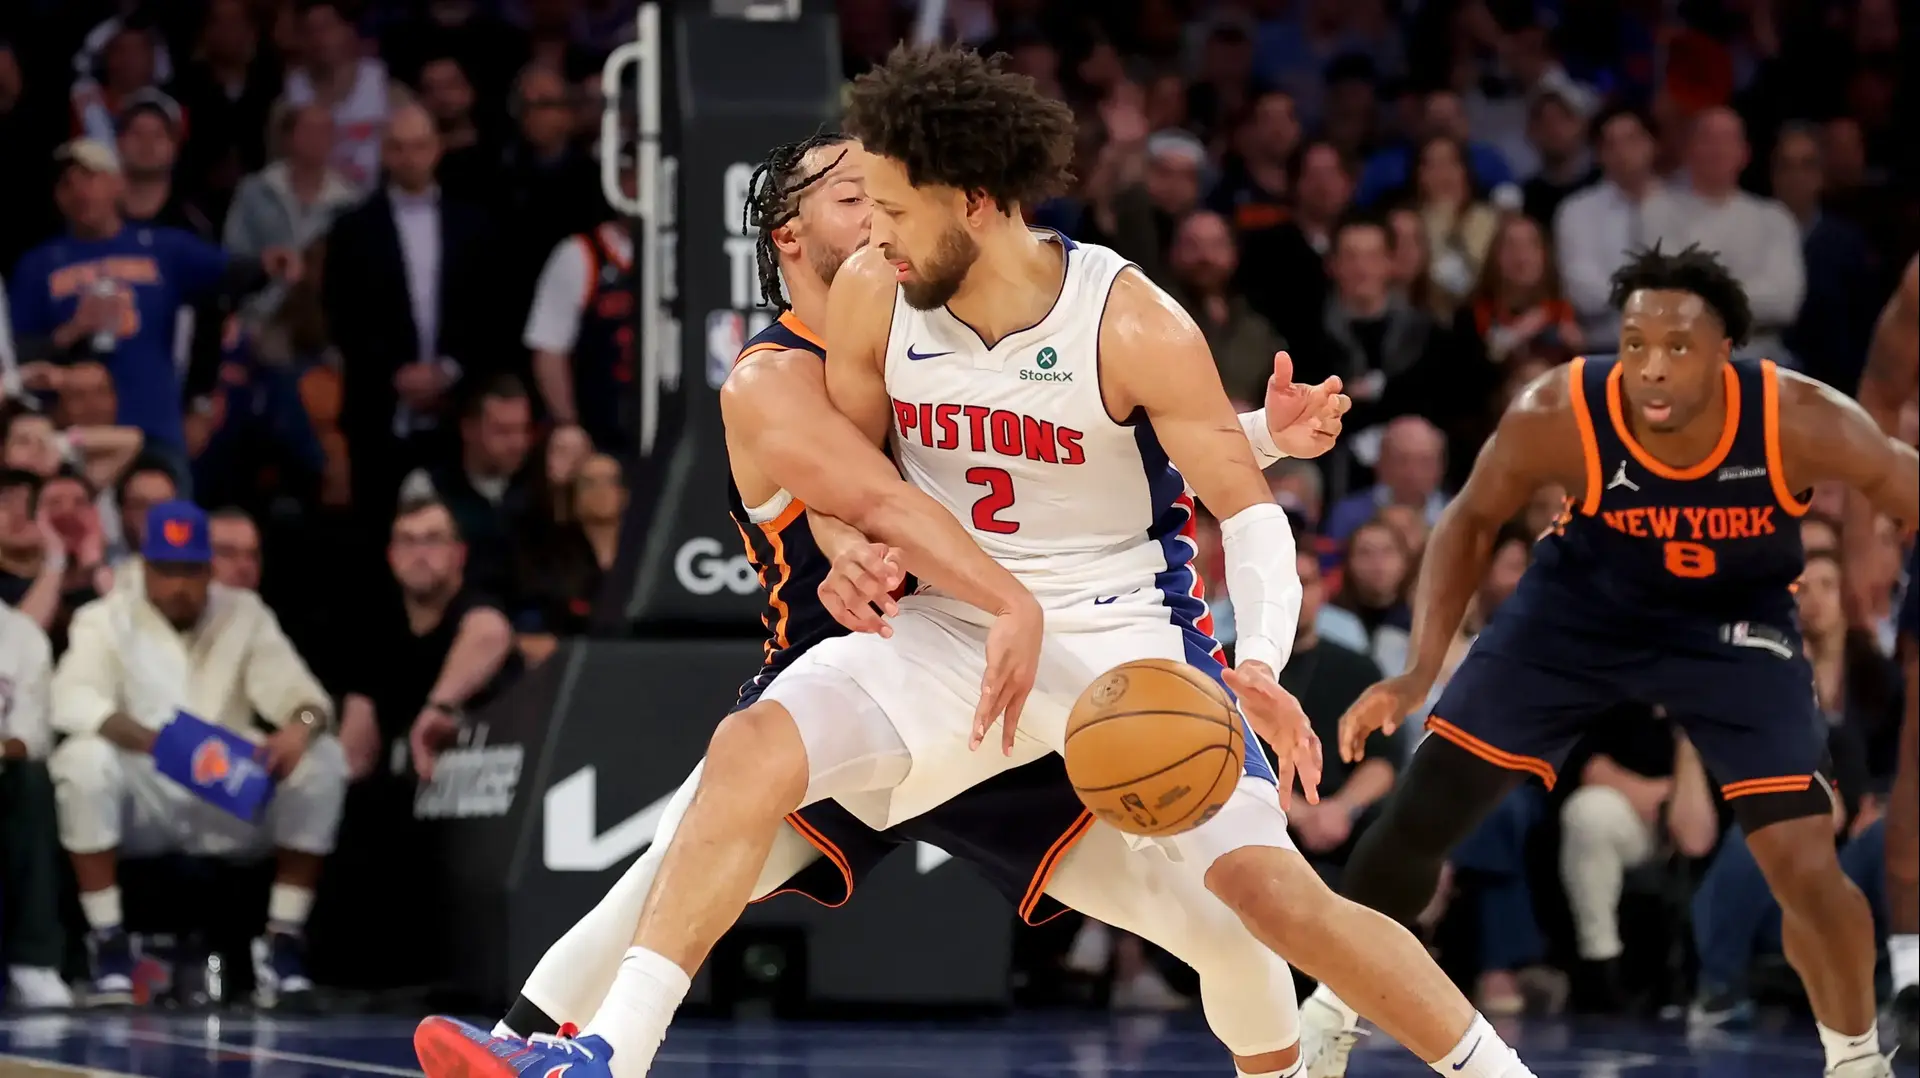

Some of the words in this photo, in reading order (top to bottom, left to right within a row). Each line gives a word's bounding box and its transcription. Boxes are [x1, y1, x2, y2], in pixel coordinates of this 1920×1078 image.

[1019, 369, 1074, 382] StockX
[893, 398, 1086, 465] PISTONS
[965, 466, 1020, 534] 2
[1602, 506, 1679, 539] NEW
[1682, 506, 1776, 540] YORK
[1663, 540, 1717, 579] 8
